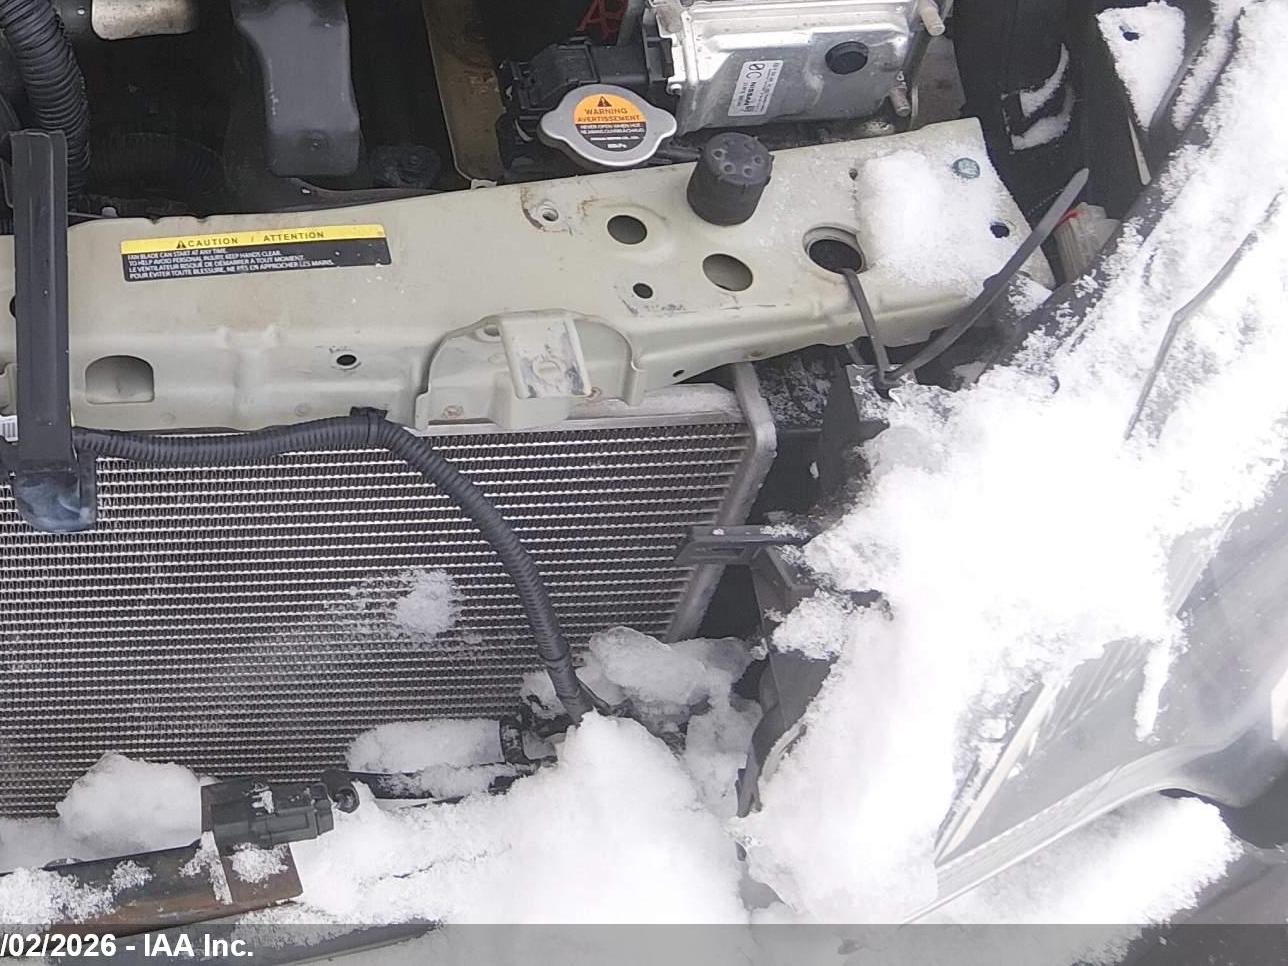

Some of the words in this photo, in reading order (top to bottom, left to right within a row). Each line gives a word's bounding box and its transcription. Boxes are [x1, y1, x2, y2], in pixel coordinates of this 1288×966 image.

[187, 237, 239, 247] CAUTION
[263, 231, 325, 242] ATTENTION
[129, 272, 149, 280] POUR
[226, 265, 236, 273] NE
[260, 260, 299, 270] APPROCHER
[137, 263, 180, 273] VENTILATEUR
